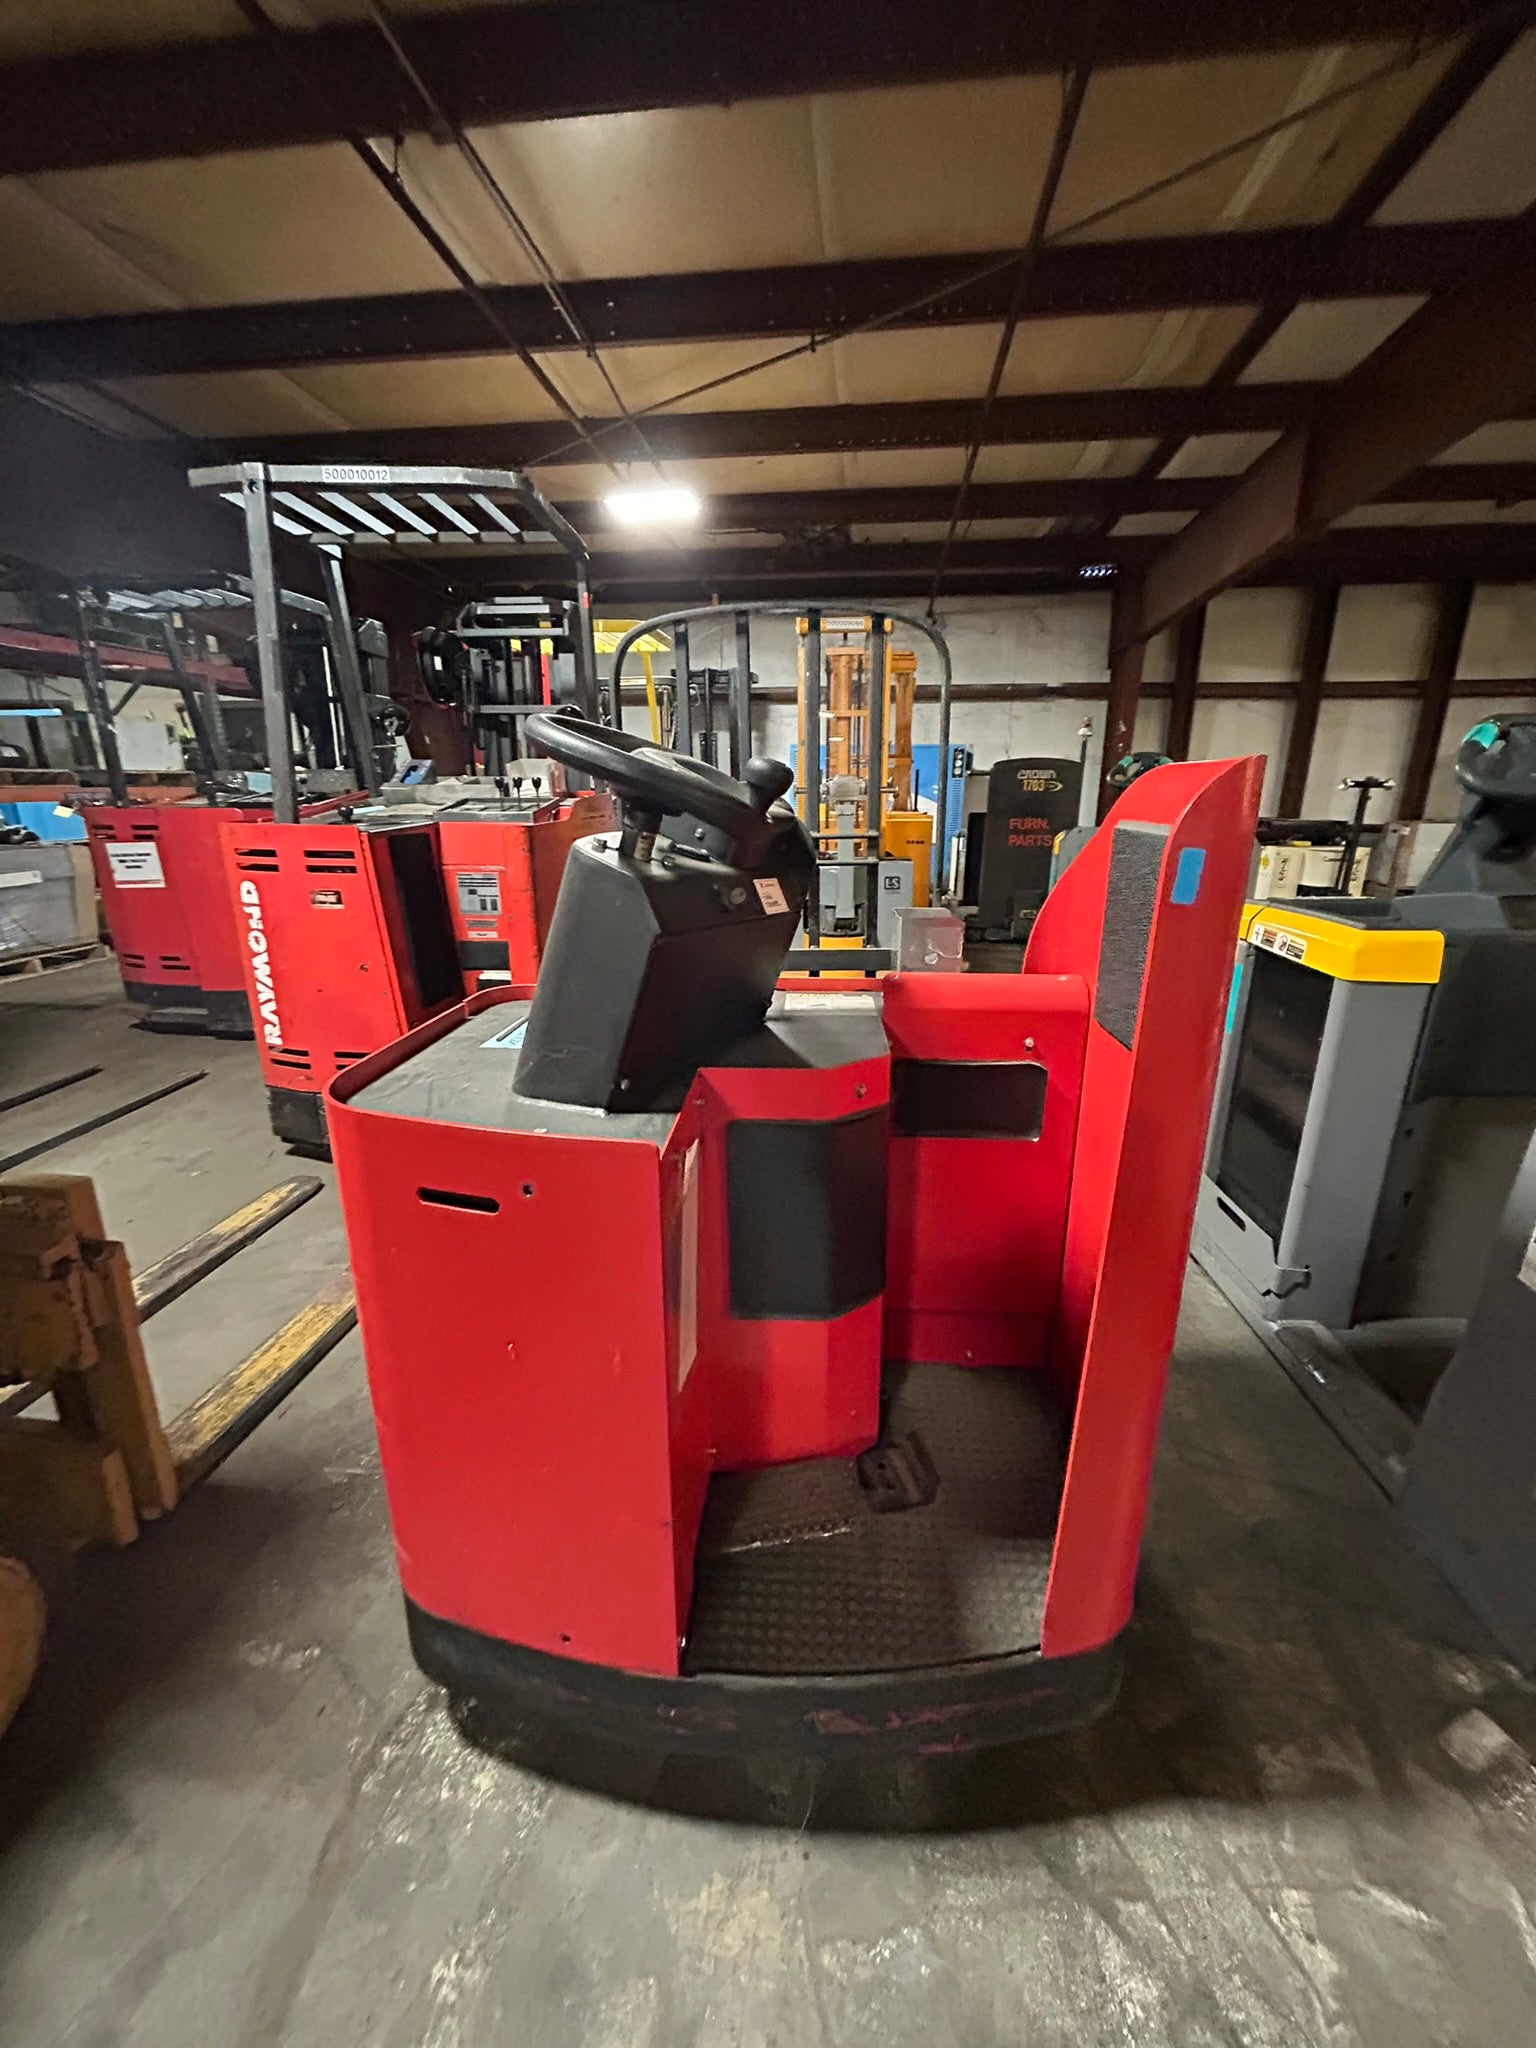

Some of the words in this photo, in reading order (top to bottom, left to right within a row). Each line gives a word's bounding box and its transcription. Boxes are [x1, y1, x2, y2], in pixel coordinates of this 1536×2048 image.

[324, 468, 388, 481] 500010012
[1008, 834, 1053, 846] PARTS
[240, 880, 283, 1045] RAYMOND
